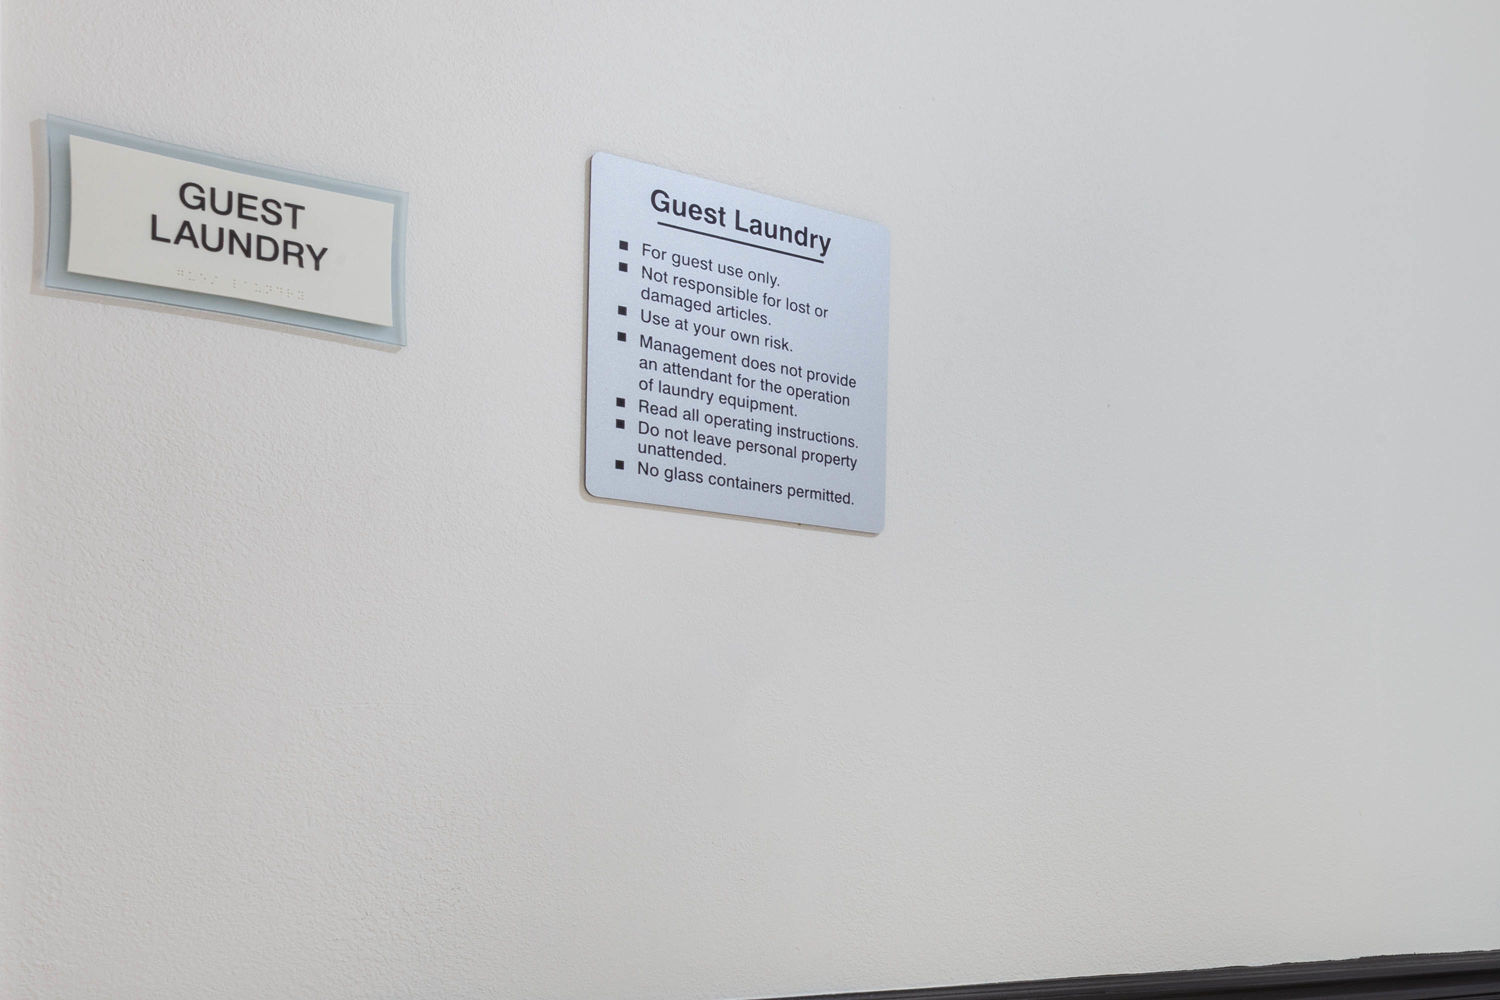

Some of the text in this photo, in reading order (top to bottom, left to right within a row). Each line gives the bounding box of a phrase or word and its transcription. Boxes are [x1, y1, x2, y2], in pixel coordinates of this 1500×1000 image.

[178, 181, 306, 230] GUEST
[650, 188, 832, 258] Guest Laundry
[150, 213, 329, 272] LAUNDRY
[641, 242, 780, 289] For guest use only.
[640, 286, 772, 326] damaged articles.
[641, 264, 829, 319] Not responsible for lost or
[640, 308, 793, 353] Use at your own risk.
[638, 358, 850, 407] an attendant for the operation
[639, 333, 857, 389] Management does not provide
[638, 377, 798, 417] of laundry equipment.
[638, 398, 859, 449] Read all operating instructions.
[638, 420, 858, 472] Do not leave personal property
[637, 442, 727, 467] unattended.
[637, 460, 855, 506] No glass containers permitted.
